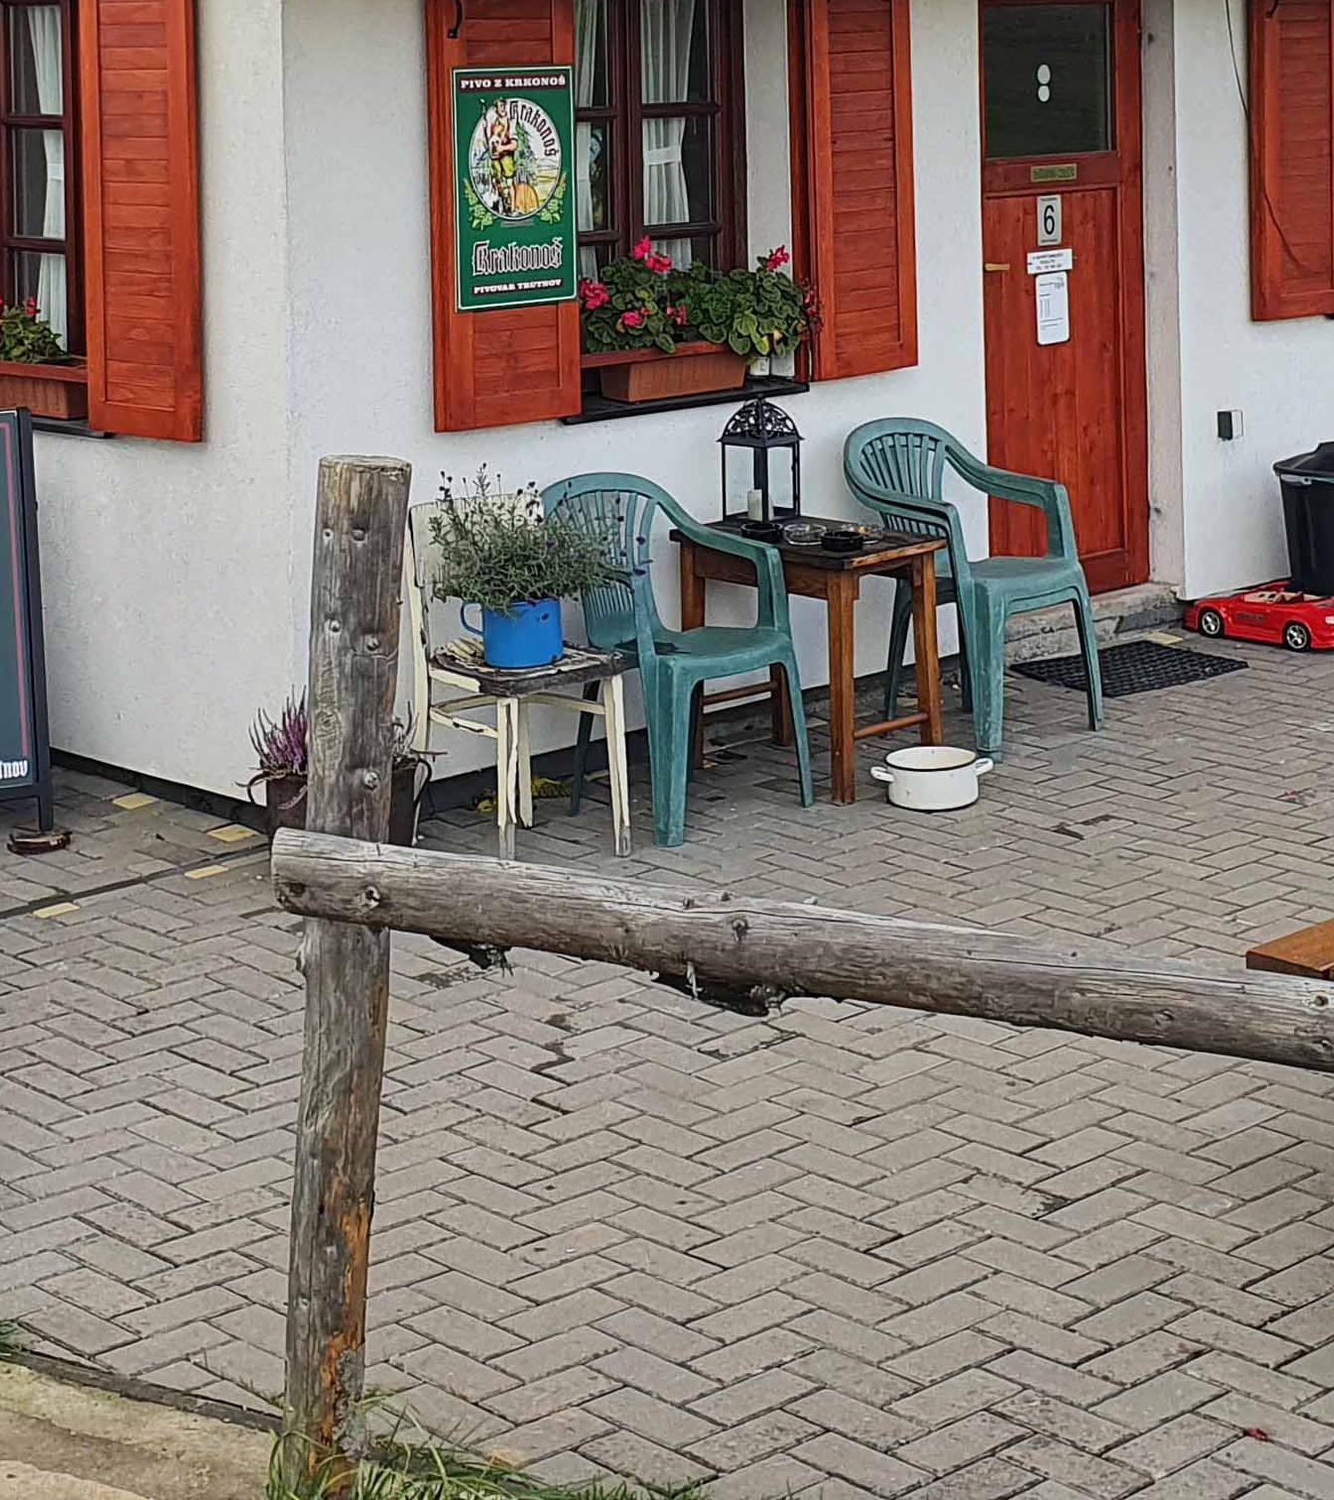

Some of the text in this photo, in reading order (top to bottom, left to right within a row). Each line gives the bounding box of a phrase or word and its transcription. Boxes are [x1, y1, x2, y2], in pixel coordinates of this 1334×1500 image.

[460, 74, 566, 89] PIVO Z KRKONOŠ
[1043, 204, 1055, 235] 6
[472, 236, 563, 276] Krakonoš
[474, 279, 562, 294] PIVOVAR TRUTNOV
